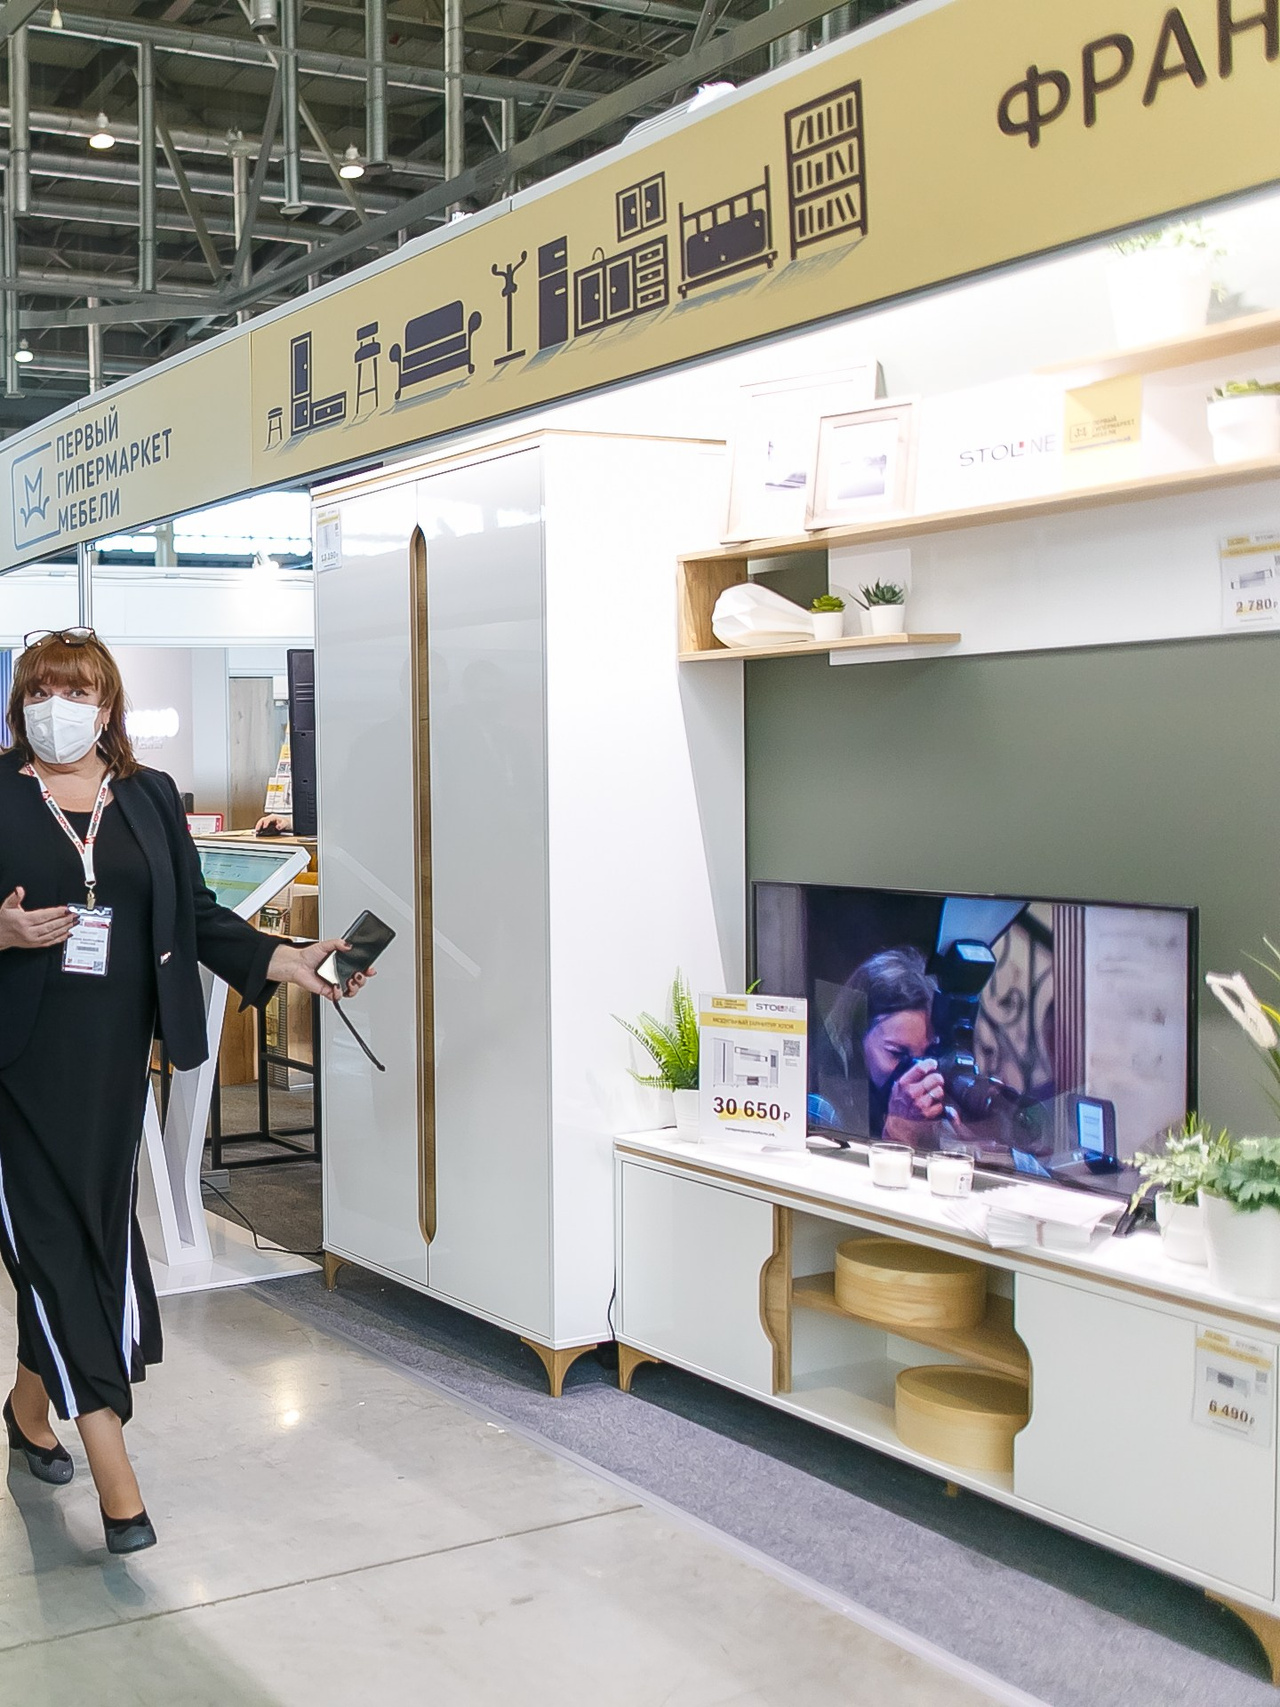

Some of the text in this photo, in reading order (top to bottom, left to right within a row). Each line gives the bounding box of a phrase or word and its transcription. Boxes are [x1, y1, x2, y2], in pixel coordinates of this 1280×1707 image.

[997, 0, 1279, 149] ФРАН
[56, 405, 119, 463] ПЕРВЫЙ
[57, 428, 172, 499] ГИПЕРМАРКЕТ
[58, 487, 120, 532] МЕБЕЛИ
[1236, 601, 1244, 613] 2
[713, 1096, 737, 1115] 30
[1209, 1399, 1218, 1413] 6
